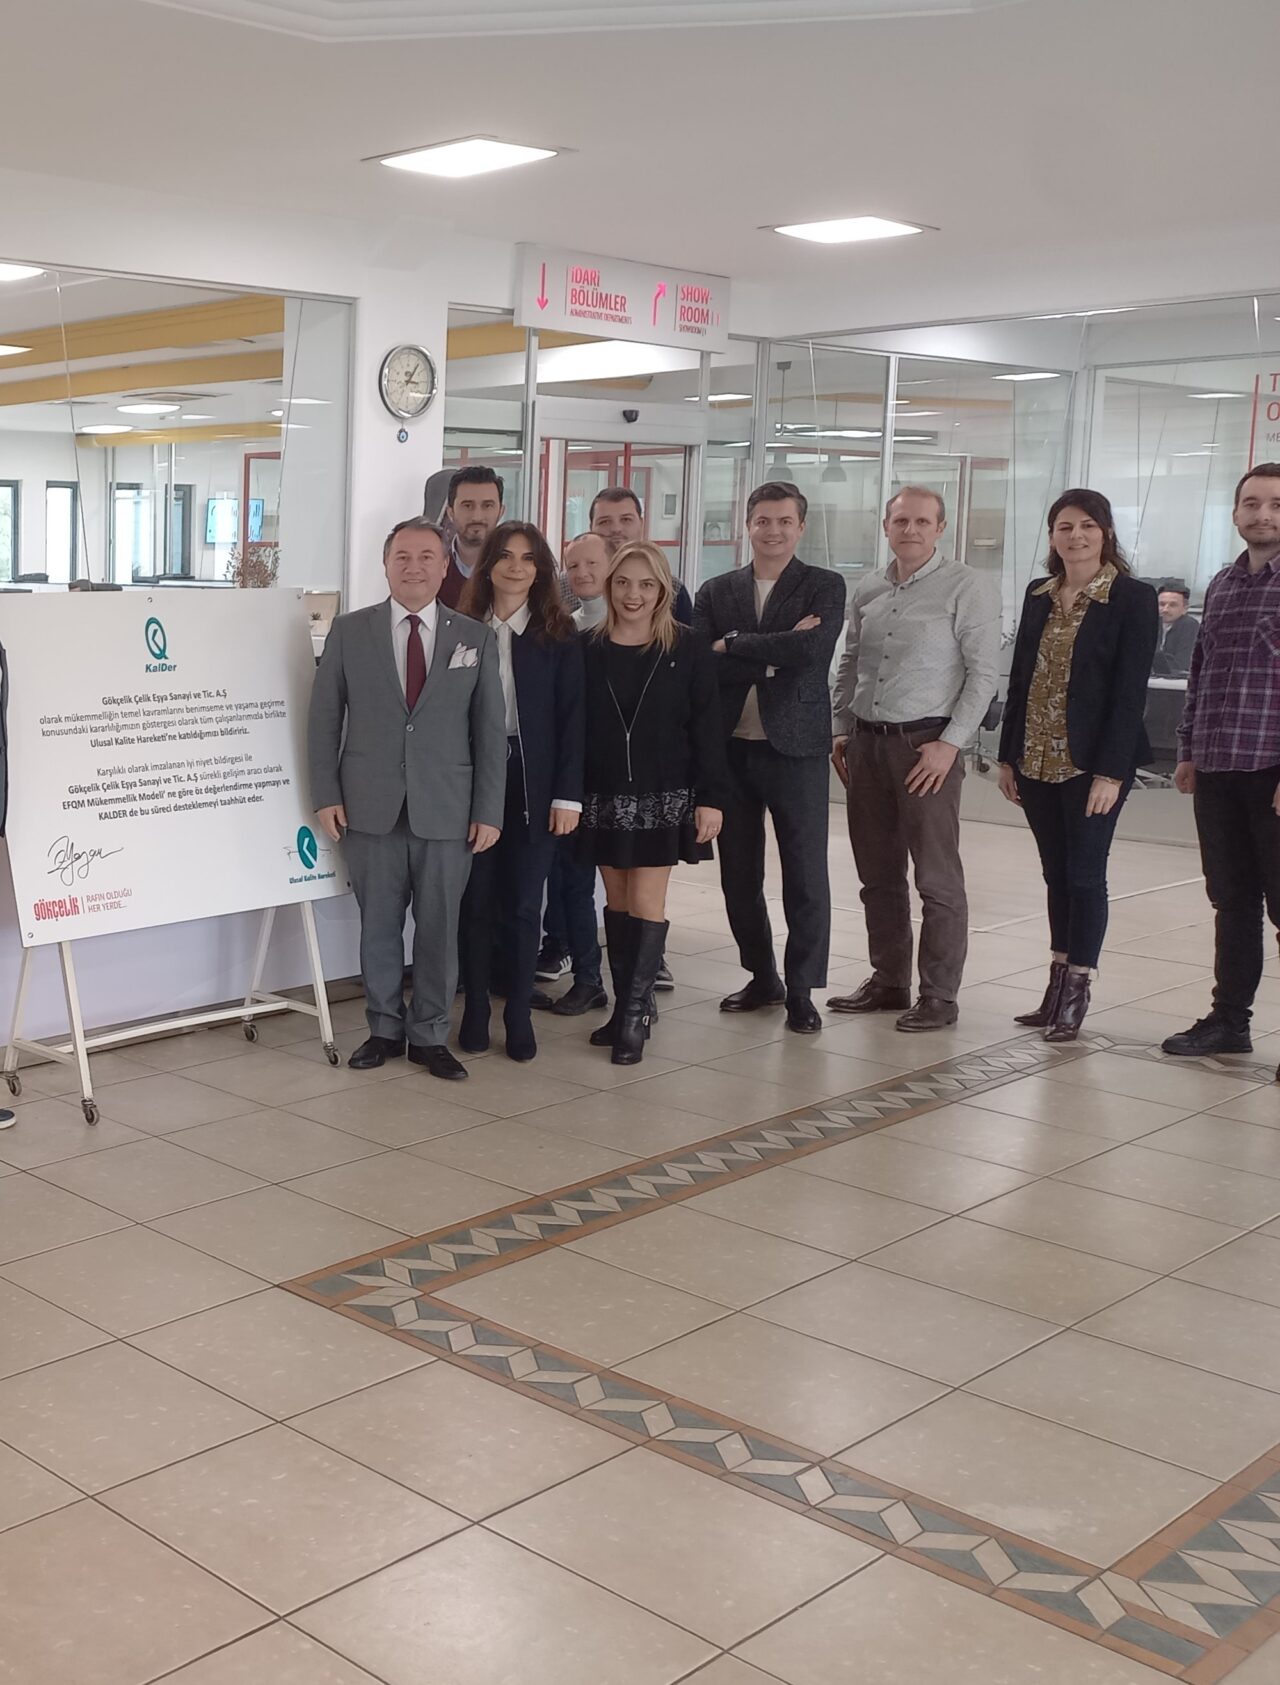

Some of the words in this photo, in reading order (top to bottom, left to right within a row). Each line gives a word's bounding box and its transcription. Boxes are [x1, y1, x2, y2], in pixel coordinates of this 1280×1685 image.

[570, 286, 627, 312] BÖLÜMLER
[679, 305, 709, 325] ROOM
[145, 663, 177, 673] KalDer
[102, 695, 133, 706] Gökçelik
[134, 694, 151, 704] Çelik
[152, 693, 168, 704] Eşya
[169, 691, 191, 701] Sanayi
[202, 690, 214, 698] Tic.
[216, 689, 227, 698] A.Ş
[40, 714, 63, 724] olarak
[65, 711, 119, 722] mükemmelliğin
[121, 709, 141, 718] temel
[142, 706, 184, 717] kavramlarını
[185, 704, 224, 714] benimseme
[234, 701, 258, 711] yaşama
[260, 699, 285, 709] geçirme
[41, 725, 88, 737] konusundaki
[142, 718, 176, 730] göstergesi
[178, 717, 198, 726] olarak
[200, 716, 213, 724] tüm
[215, 712, 263, 724] çalışanlarımızla
[90, 738, 113, 747] Ulusal
[115, 736, 135, 746] Kalite
[178, 729, 219, 740] katıldığımızı
[220, 727, 250, 736] bildiririz.
[97, 765, 126, 777] Karşılıklı
[128, 763, 149, 774] olarak
[150, 760, 186, 770] imzalanan
[187, 759, 195, 769] iyi
[196, 758, 212, 767] niyet
[214, 755, 243, 765] bildirgesi
[68, 783, 100, 794] Gökçelik
[102, 781, 120, 793] Çelik
[121, 780, 137, 790] Eşya
[139, 776, 162, 787] Sanayi
[172, 774, 185, 783] Tic.
[187, 773, 198, 783] A.Ş
[200, 770, 221, 780] sürekli
[223, 768, 246, 779] gelişim
[247, 767, 262, 776] aracı
[263, 764, 283, 773] olarak
[62, 800, 85, 810] EFQM
[87, 795, 137, 807] Mükemmellik
[178, 788, 194, 799] göre
[195, 786, 203, 795] öz
[205, 782, 252, 795] değerlendirme
[254, 779, 281, 790] yapmayı
[99, 809, 128, 820] KALDER
[129, 808, 138, 817] de
[140, 806, 149, 816] bu
[151, 805, 172, 815] süreci
[174, 801, 219, 812] desteklemeyi
[220, 796, 246, 806] taahhüt
[248, 794, 264, 803] eder.
[86, 891, 105, 903] RAFIN
[106, 888, 132, 899] OLDUĞU
[88, 904, 101, 913] HER
